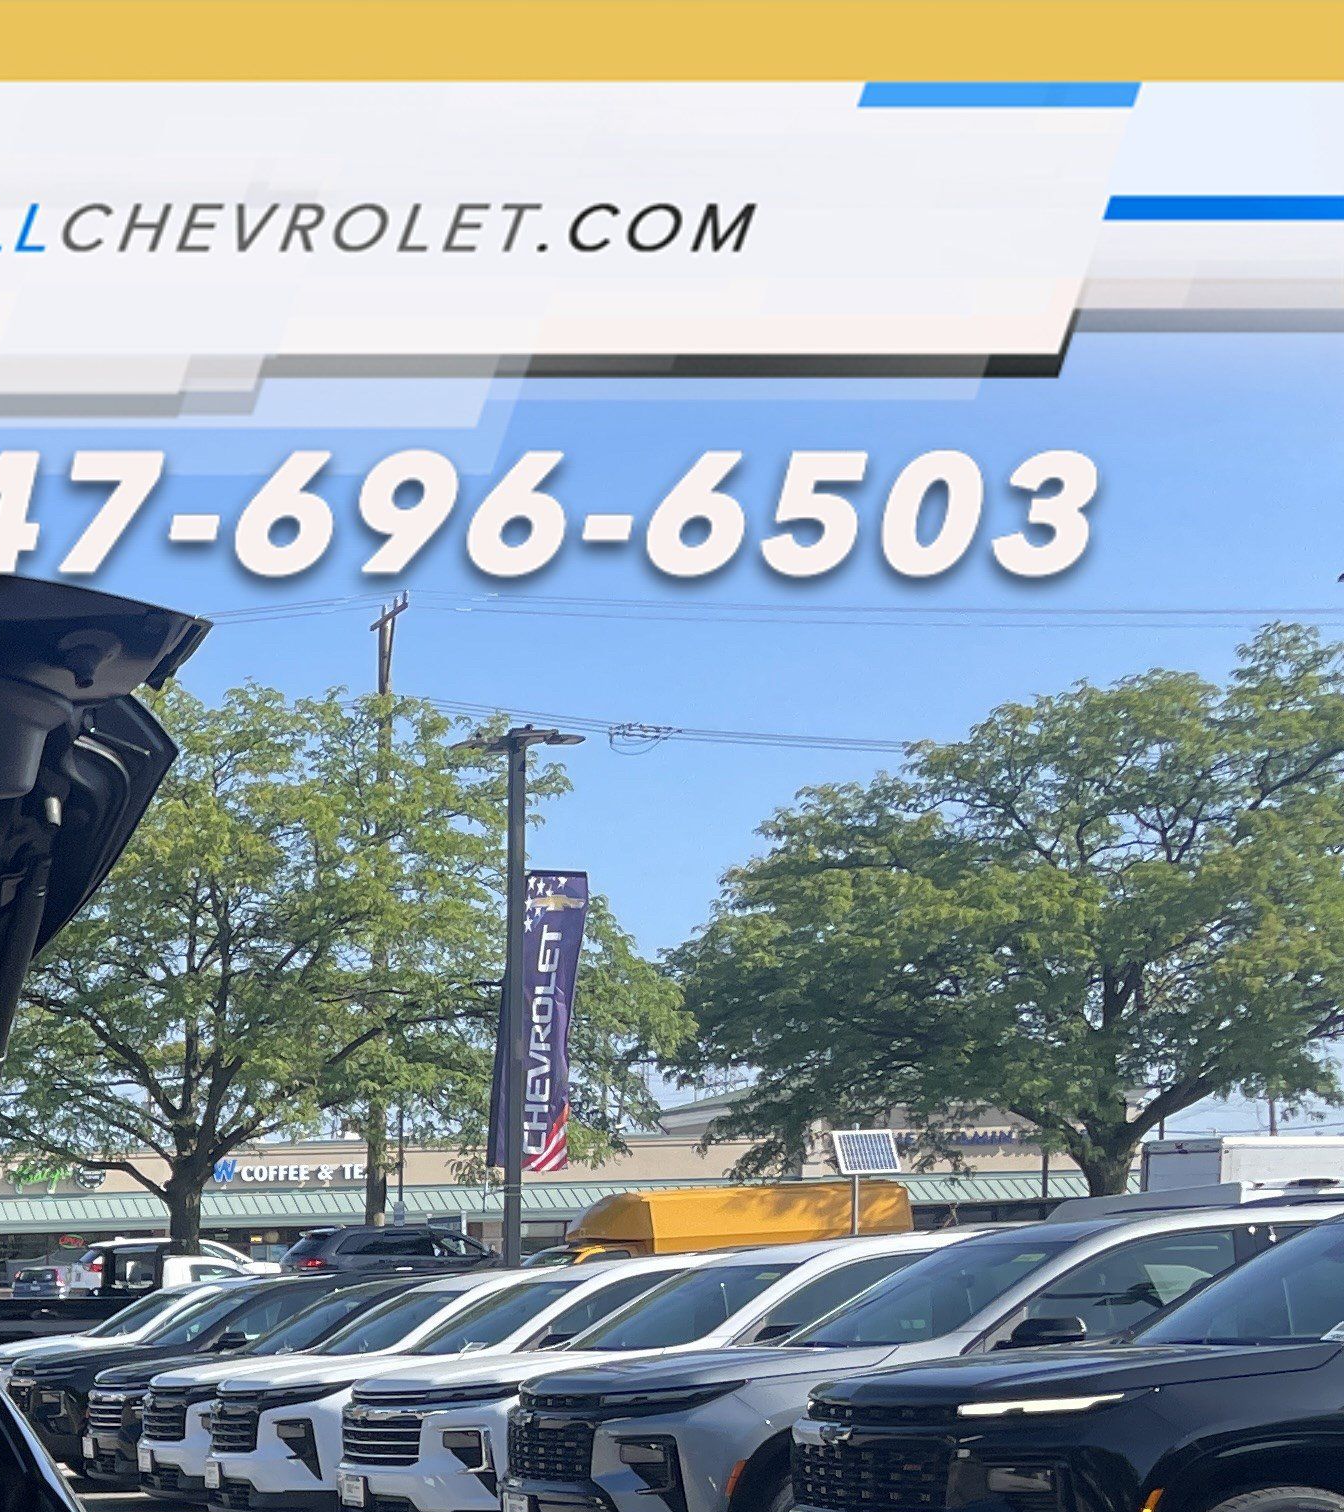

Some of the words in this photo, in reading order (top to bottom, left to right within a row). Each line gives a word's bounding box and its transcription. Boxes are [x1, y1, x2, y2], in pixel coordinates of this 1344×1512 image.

[522, 924, 563, 1155] CHEVROLET
[241, 1165, 310, 1182] COFFEE
[317, 1164, 334, 1180] &
[342, 1163, 368, 1180] TE
